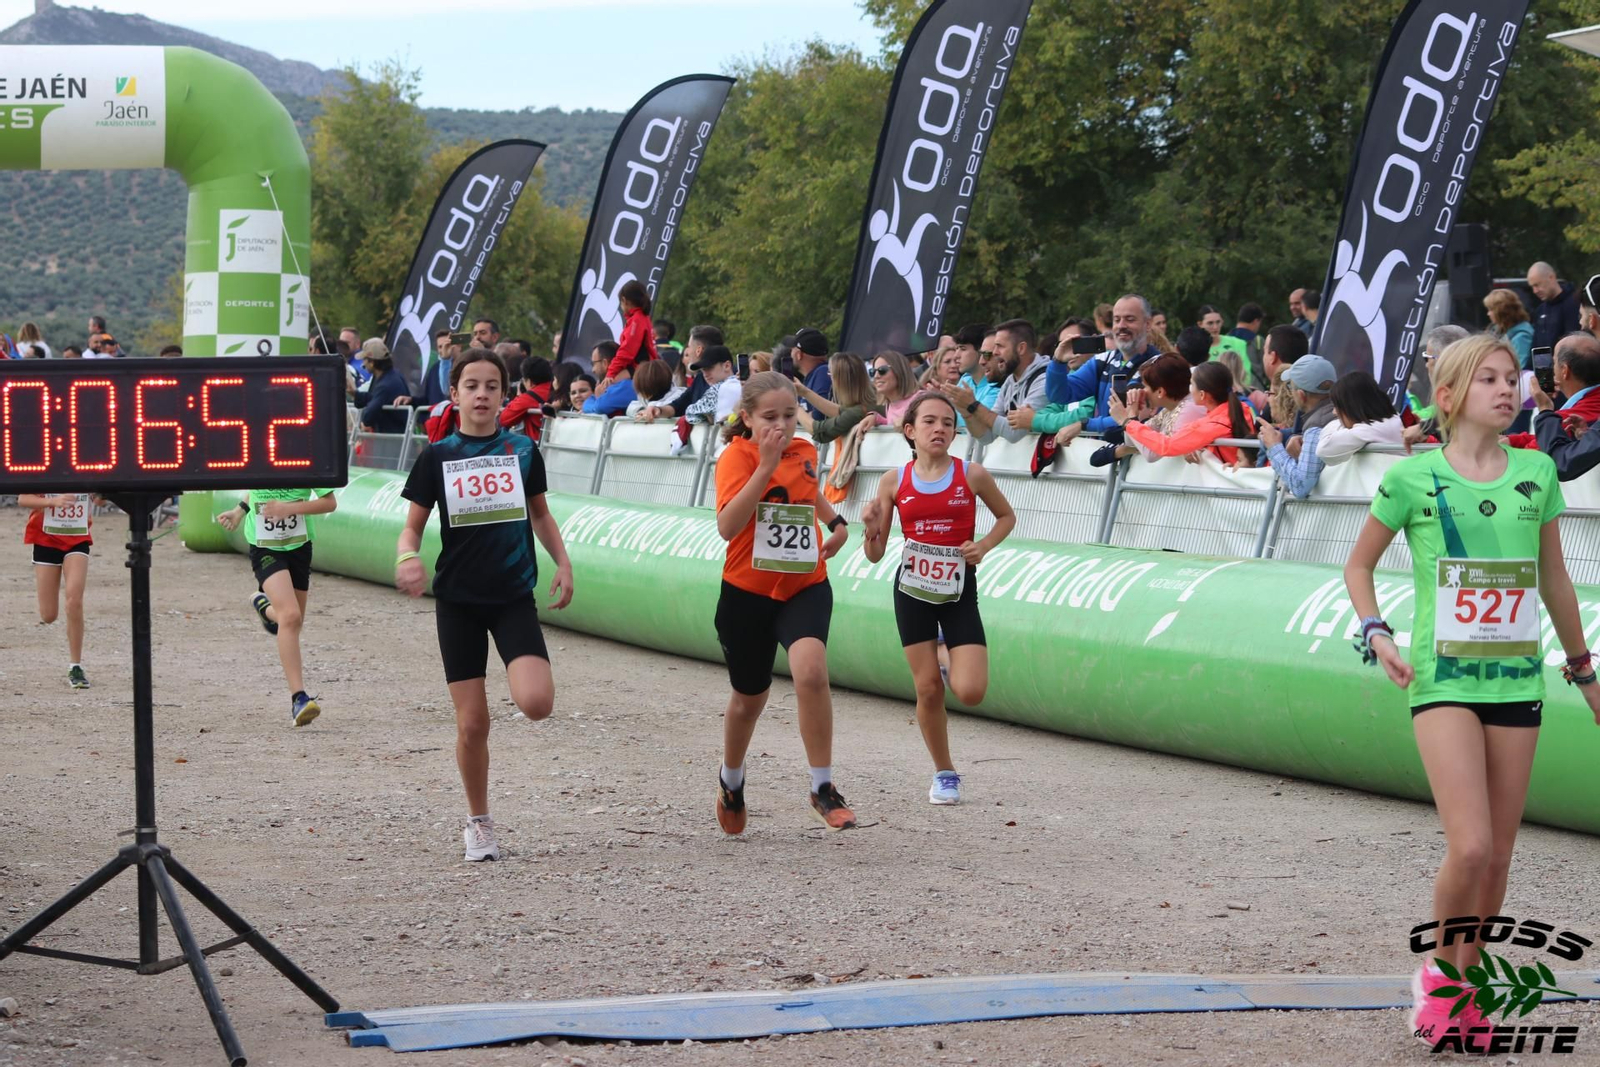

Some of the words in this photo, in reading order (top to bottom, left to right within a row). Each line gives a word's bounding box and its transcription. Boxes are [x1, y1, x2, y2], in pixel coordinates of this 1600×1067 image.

[14, 73, 86, 99] JAÉN
[104, 100, 148, 119] Jaén
[452, 472, 514, 498] 1363
[459, 505, 483, 514] RUEDA
[484, 502, 515, 511] BERRIOS
[264, 514, 297, 532] 543
[624, 512, 728, 562] IPUTACIÓN
[767, 524, 810, 550] 328
[907, 574, 929, 584] MONTOYA
[908, 555, 958, 581] 1057
[1454, 589, 1525, 624] 527
